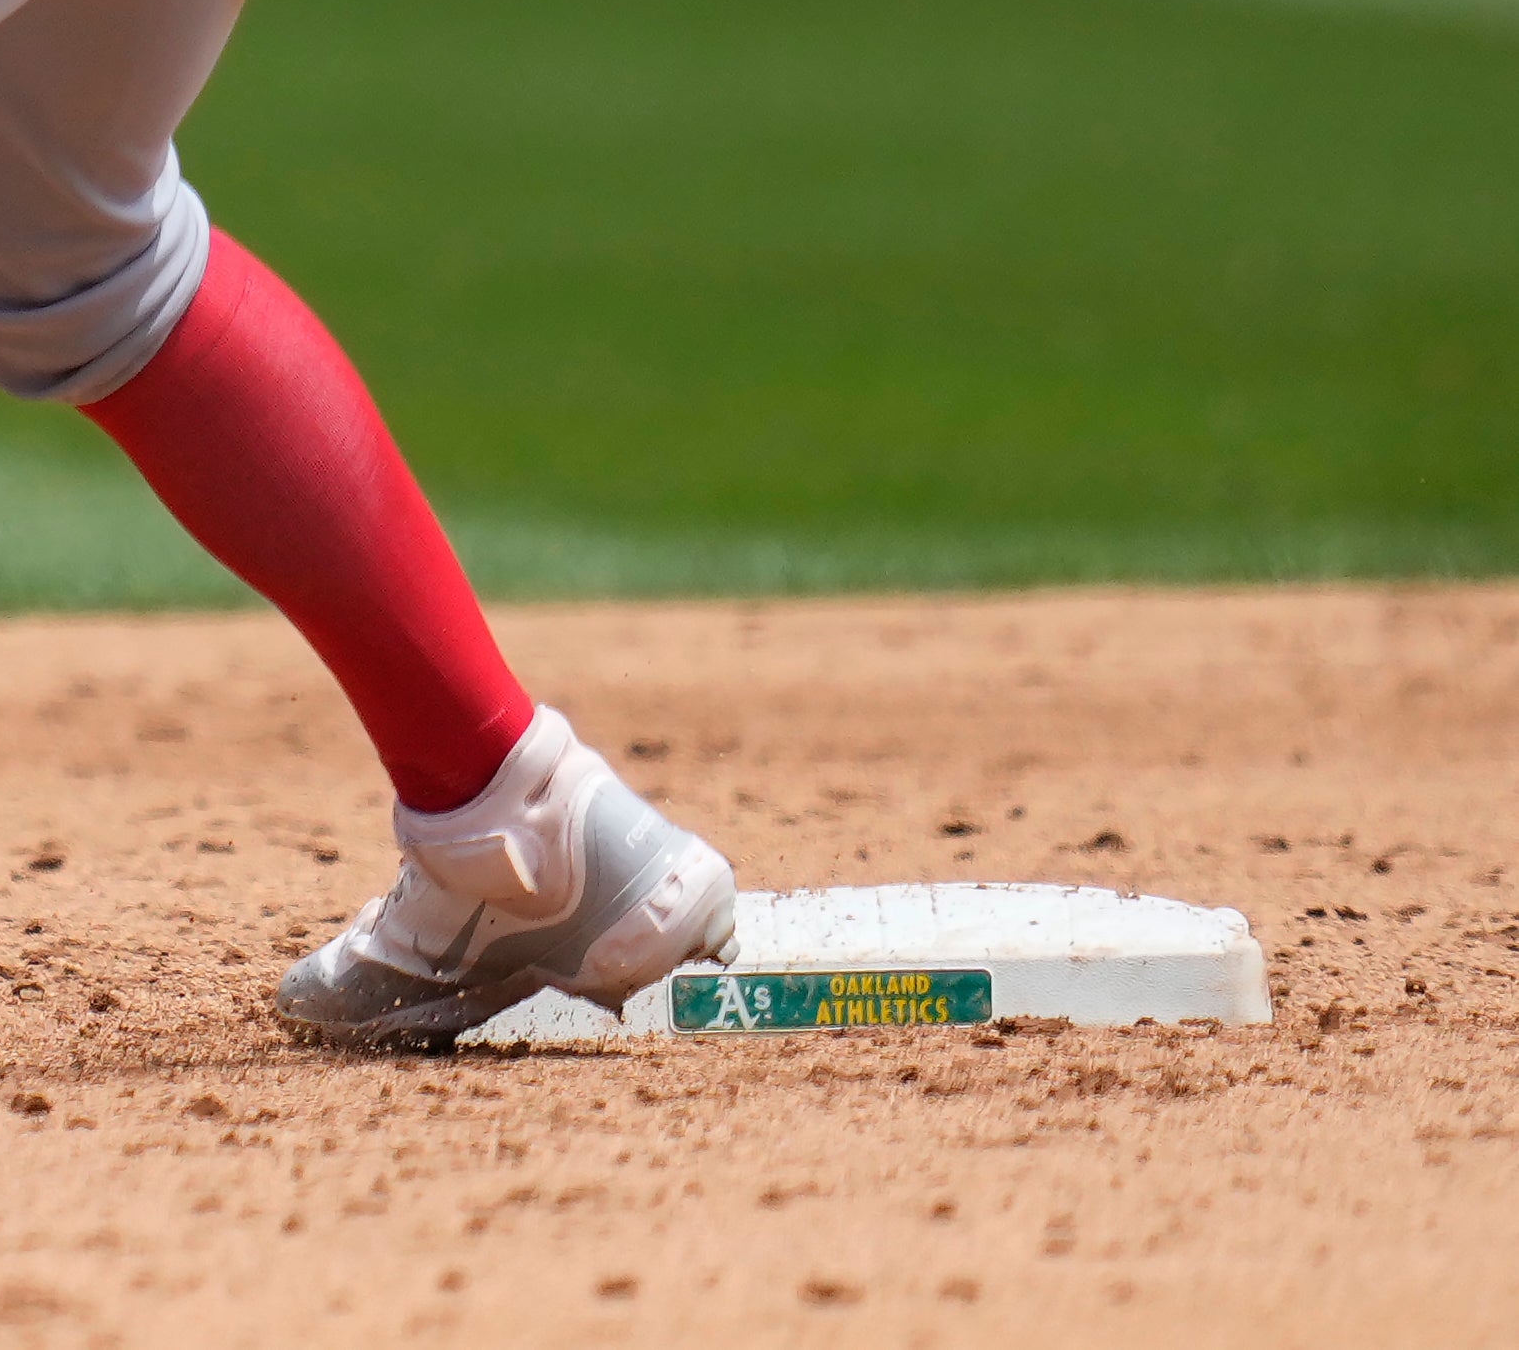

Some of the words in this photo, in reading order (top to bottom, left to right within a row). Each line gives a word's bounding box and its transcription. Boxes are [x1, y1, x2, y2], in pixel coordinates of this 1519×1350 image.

[829, 974, 933, 997] OAKLAND
[705, 976, 772, 1030] A's
[816, 996, 950, 1026] ATHLETICS
